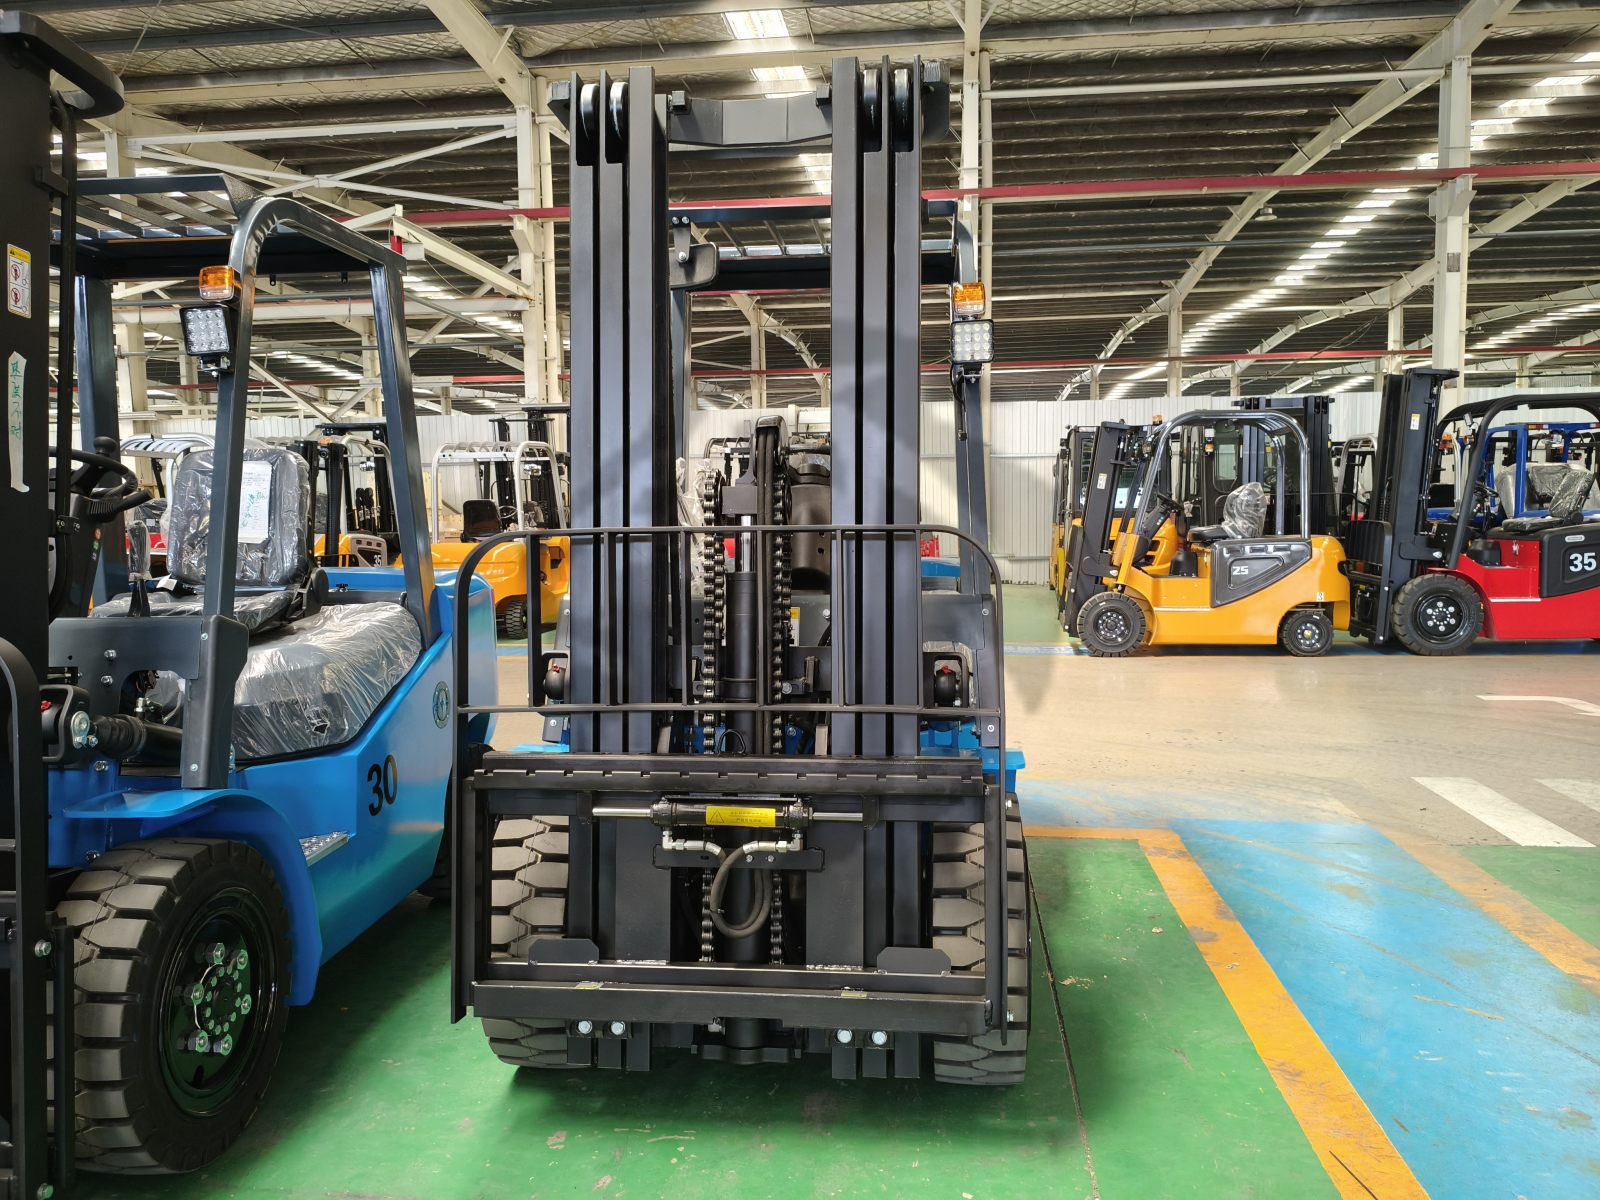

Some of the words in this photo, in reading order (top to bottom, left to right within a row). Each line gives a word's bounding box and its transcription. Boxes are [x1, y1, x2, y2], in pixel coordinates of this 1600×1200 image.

[1232, 565, 1249, 575] 25
[1569, 552, 1597, 572] 35
[367, 754, 398, 817] 30
